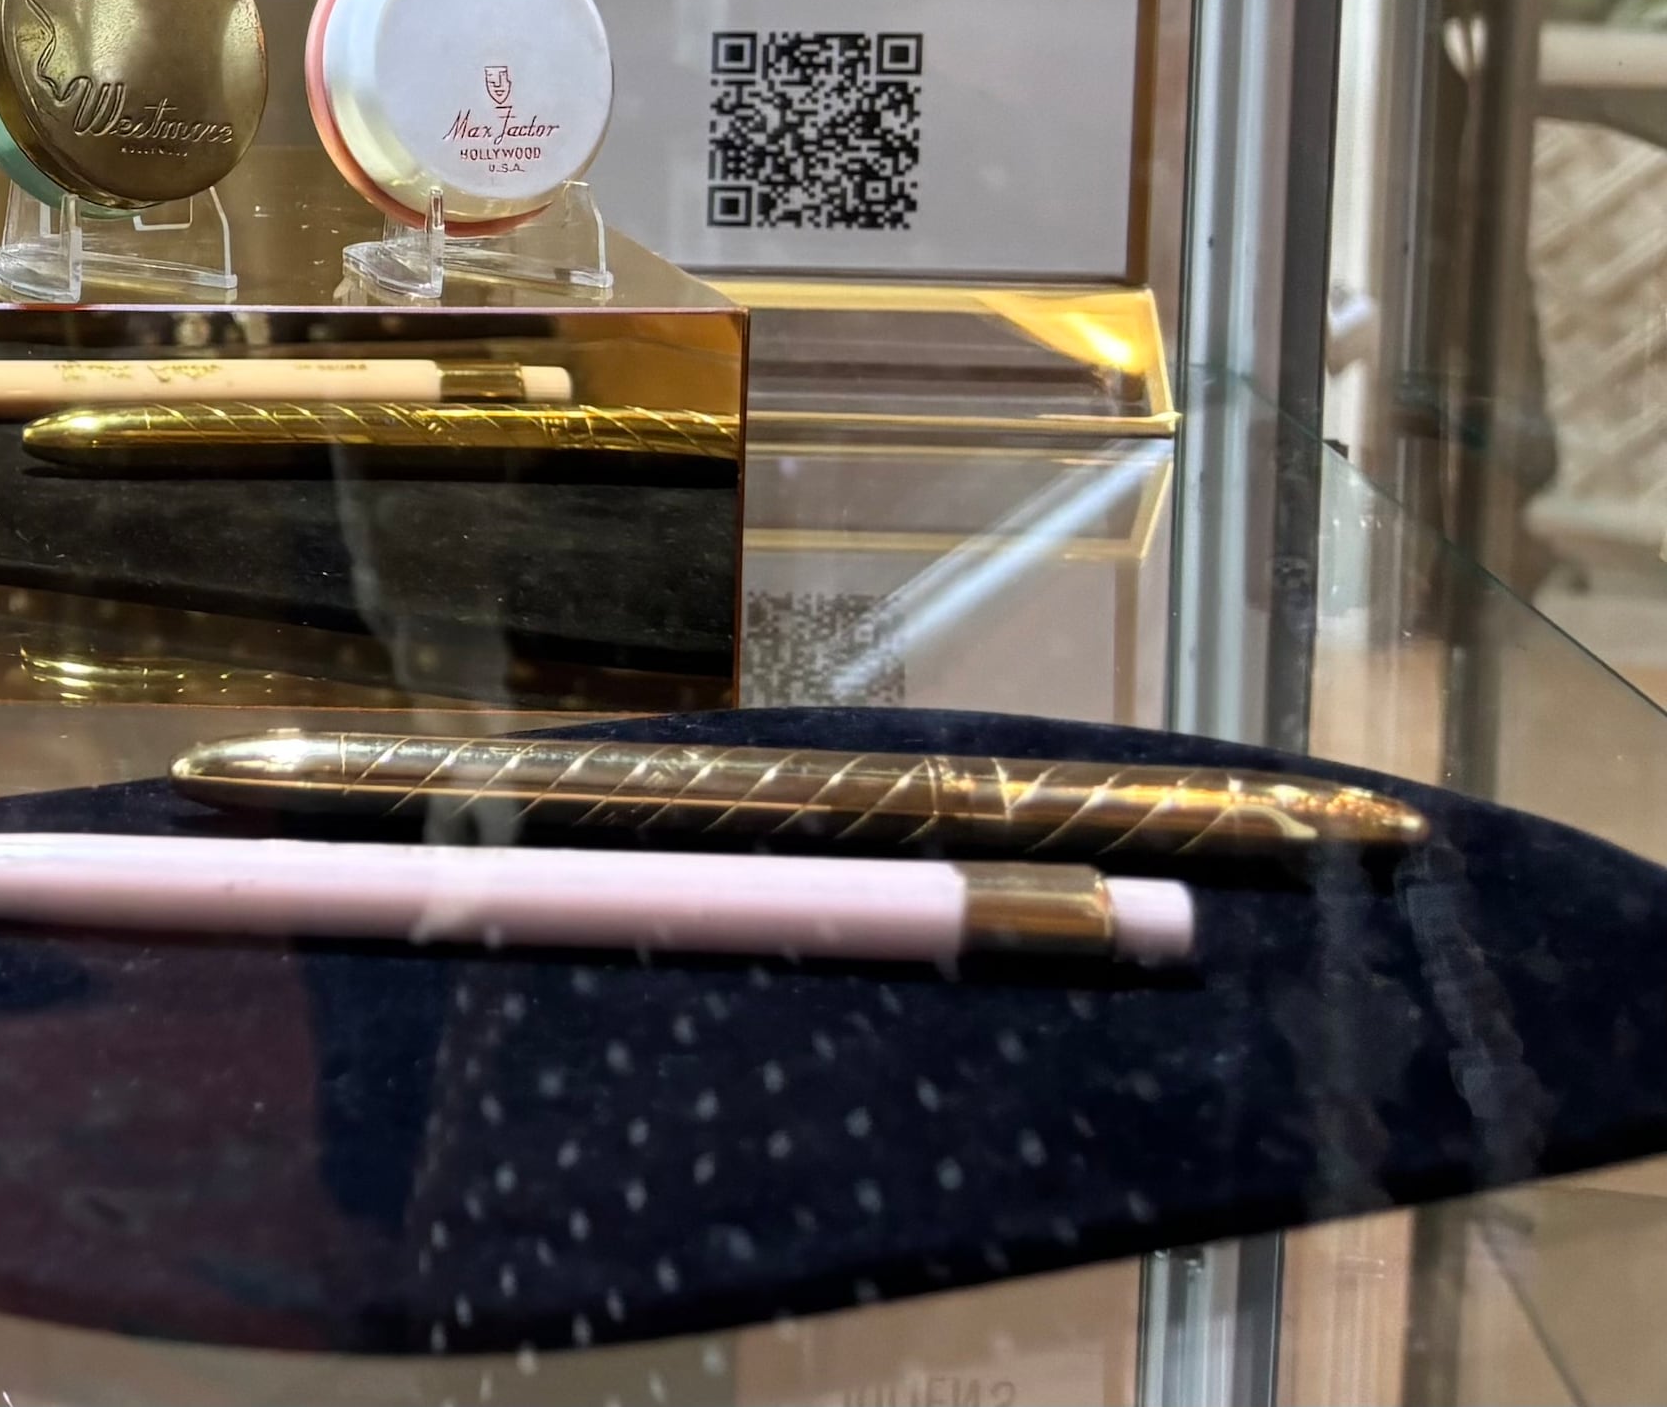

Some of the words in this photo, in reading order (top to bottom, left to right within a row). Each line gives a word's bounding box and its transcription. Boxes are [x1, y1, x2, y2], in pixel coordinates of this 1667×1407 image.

[442, 109, 492, 141] Max
[494, 105, 560, 145] Factor
[460, 147, 541, 161] HOLLYWOOD
